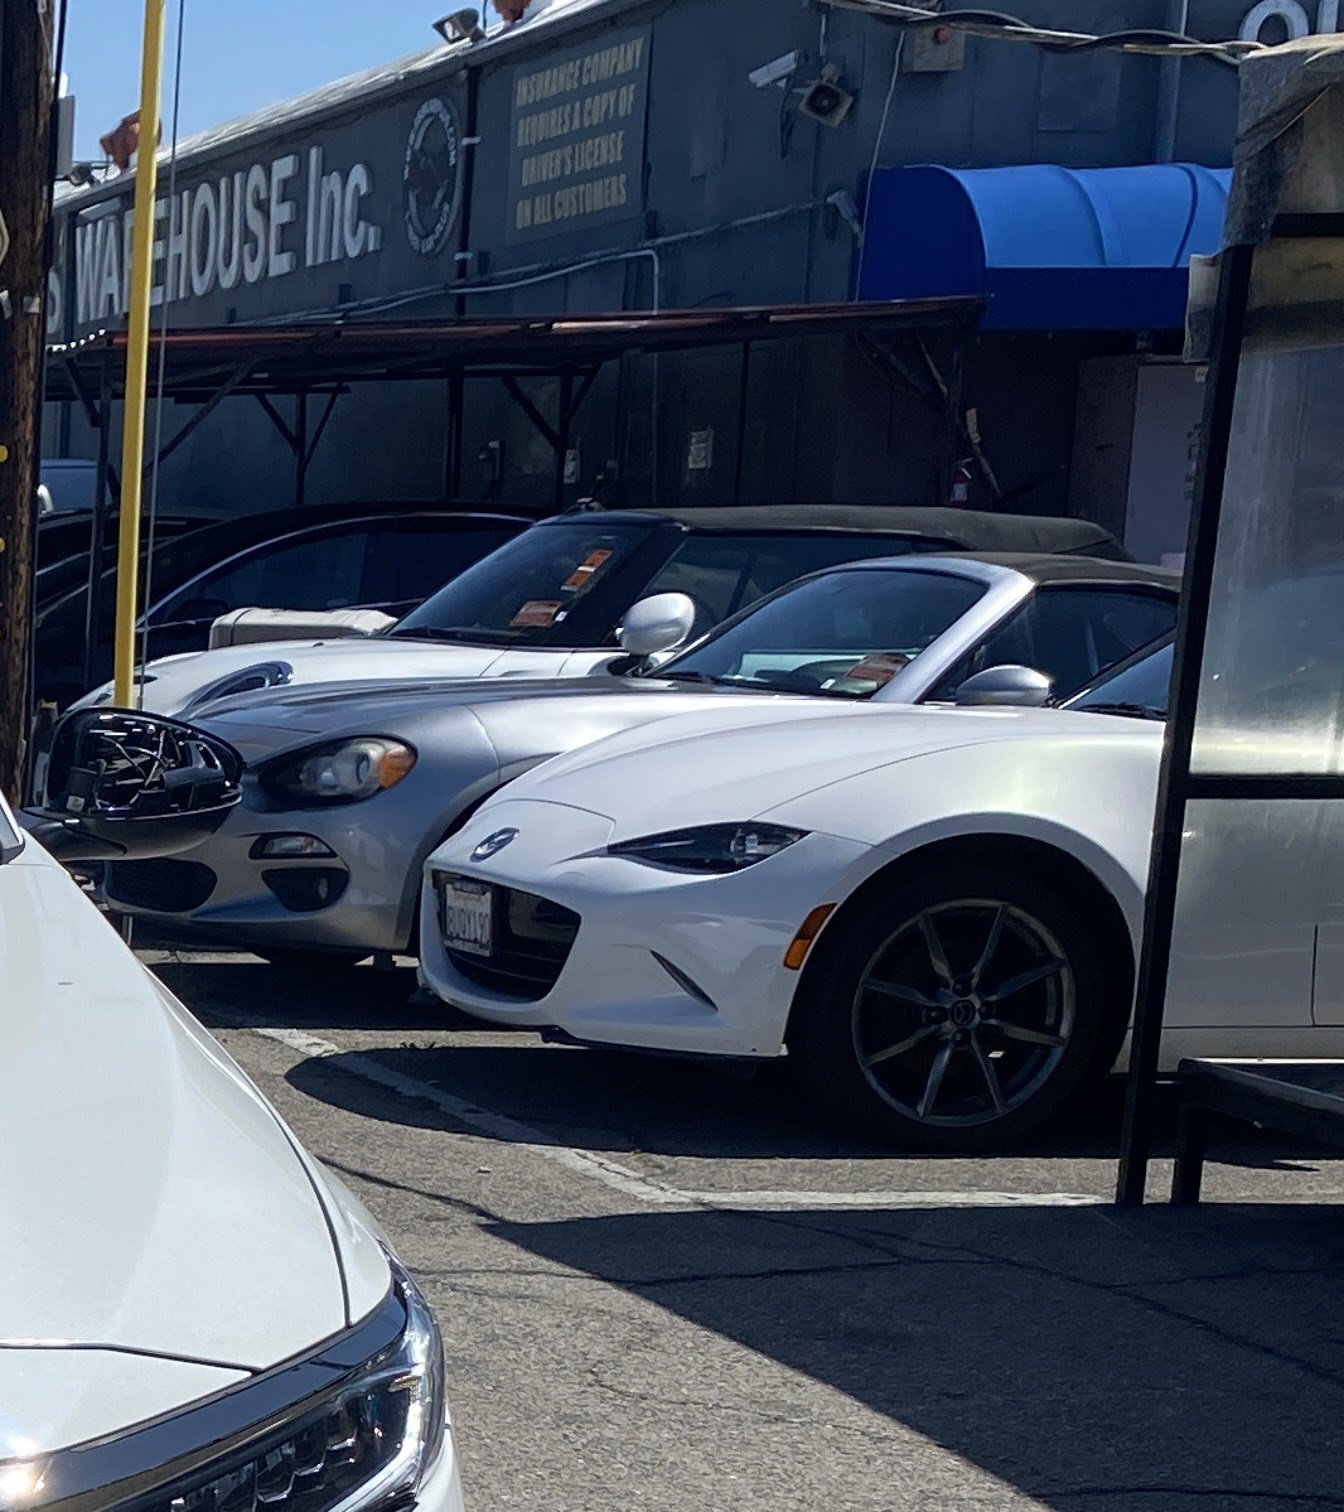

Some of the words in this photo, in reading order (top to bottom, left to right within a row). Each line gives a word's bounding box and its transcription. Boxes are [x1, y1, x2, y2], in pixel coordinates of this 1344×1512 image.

[516, 58, 580, 107] INSURANCE
[582, 37, 644, 86] COMPANY
[517, 103, 571, 147] REQUIRES
[571, 100, 581, 131] A
[583, 90, 617, 128] COPY
[618, 83, 636, 118] OF
[522, 145, 572, 187] DRIVER'S
[574, 129, 625, 174] LICENSE
[305, 145, 382, 267] Inc.
[516, 199, 532, 229] ON
[533, 193, 552, 225] ALL
[554, 174, 627, 220] CUSTOMERS
